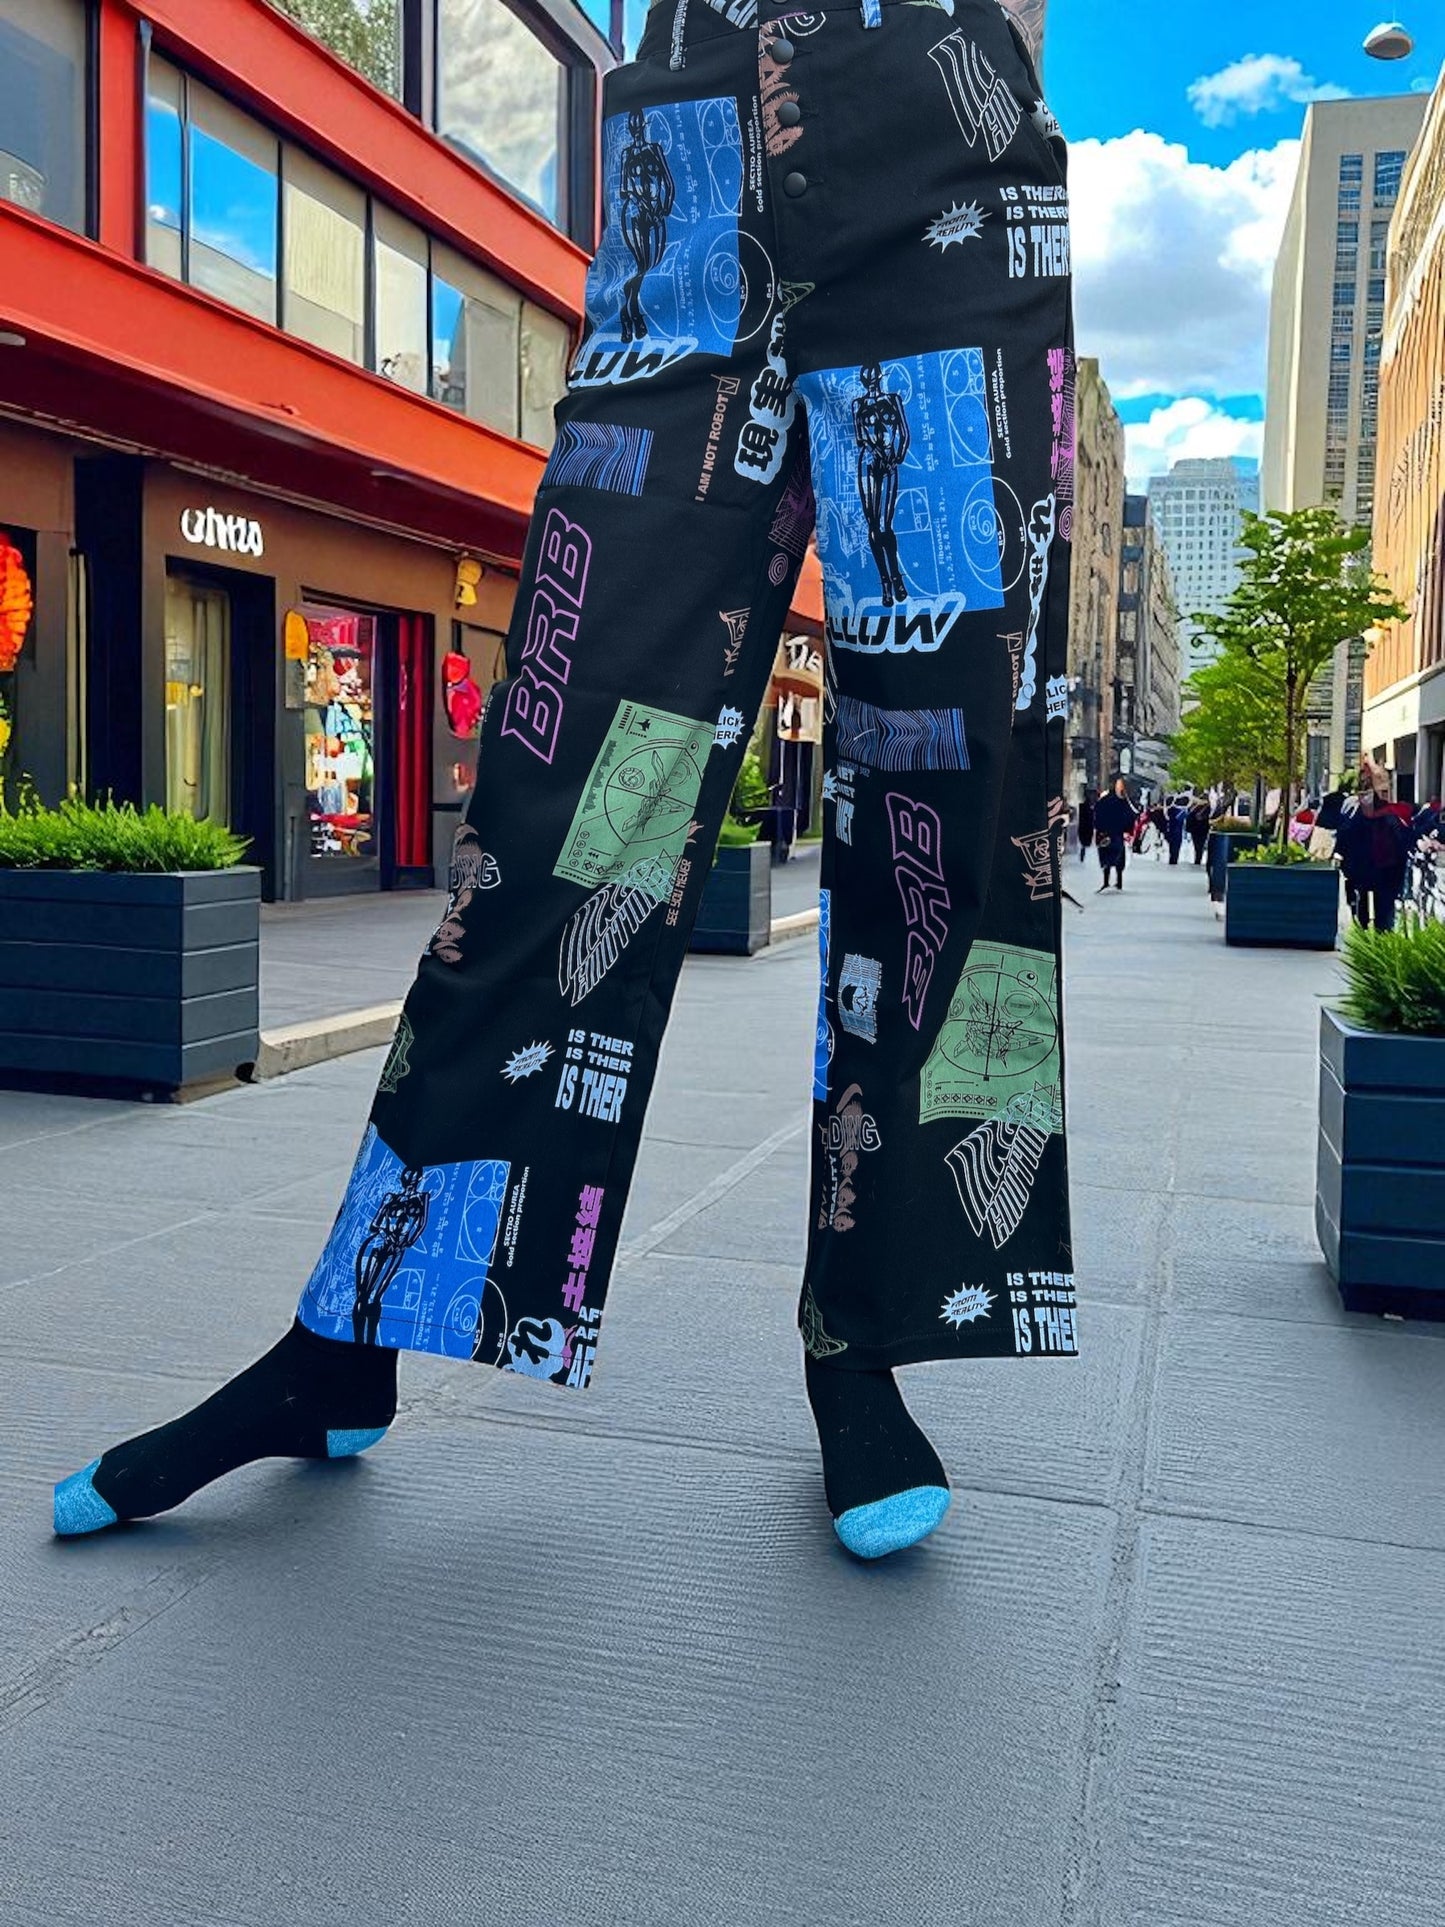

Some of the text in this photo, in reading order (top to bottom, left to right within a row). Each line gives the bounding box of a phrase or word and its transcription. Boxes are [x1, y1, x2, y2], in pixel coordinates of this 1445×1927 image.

[747, 119, 756, 154] AUREA
[752, 95, 762, 150] proportion
[756, 189, 764, 213] Gold
[1000, 187, 1019, 201] IS
[937, 221, 976, 237] REALITY
[1006, 205, 1024, 220] IS
[1007, 226, 1026, 279] IS
[709, 393, 729, 441] ROBOT
[991, 369, 1004, 439] SECTIO AUREA
[996, 348, 1012, 459] Gold section proportion
[702, 442, 718, 472] NOT
[697, 472, 712, 495] AM
[500, 508, 592, 765] BRB
[665, 858, 692, 927] SEE YOU NEVER
[565, 1046, 632, 1074] IS THER
[567, 1028, 634, 1057] IS THER
[554, 1063, 628, 1124] IS THER
[503, 1183, 520, 1247] SECTIO AUREA
[506, 1166, 530, 1268] Gold section proportion
[1006, 1271, 1075, 1287] IS THER
[1010, 1290, 1028, 1303] IS
[951, 1301, 986, 1317] REALITY
[1012, 1308, 1033, 1353] IS
